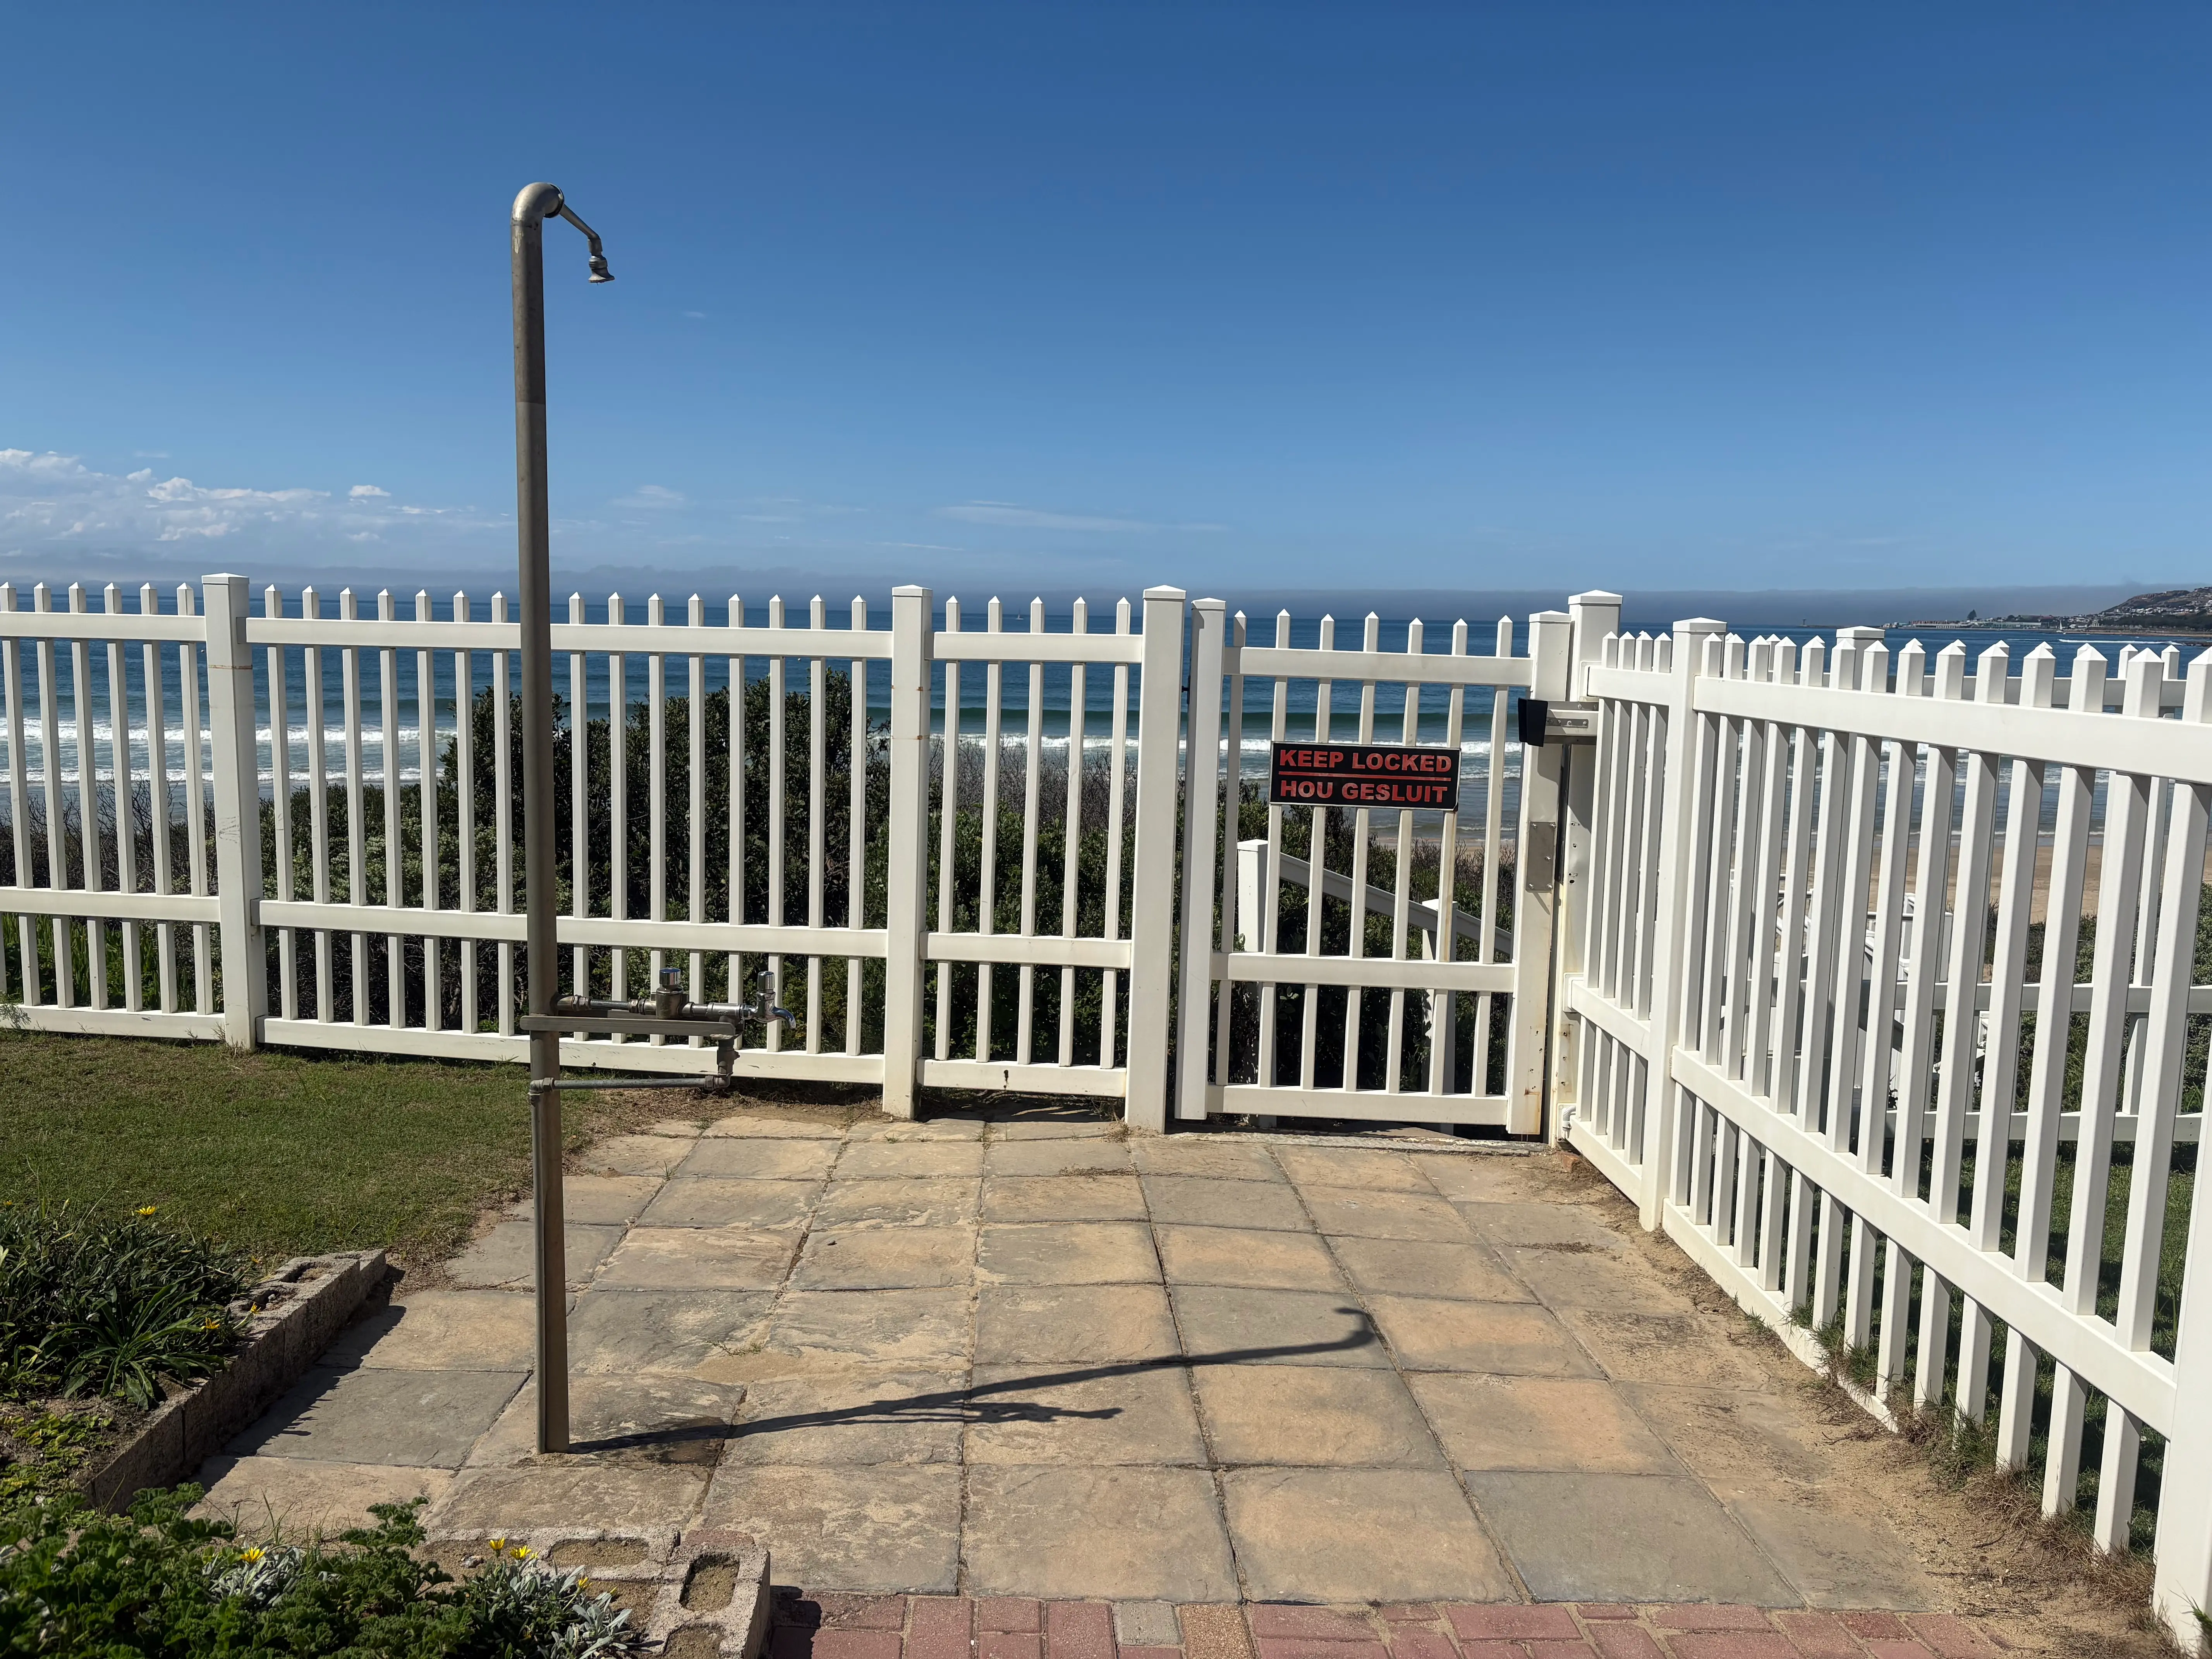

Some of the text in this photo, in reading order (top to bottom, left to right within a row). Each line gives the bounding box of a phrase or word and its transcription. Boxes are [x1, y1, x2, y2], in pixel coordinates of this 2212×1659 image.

[1280, 749, 1451, 772] KEEP LOCKED
[1280, 780, 1448, 803] HOU GESLUIT
